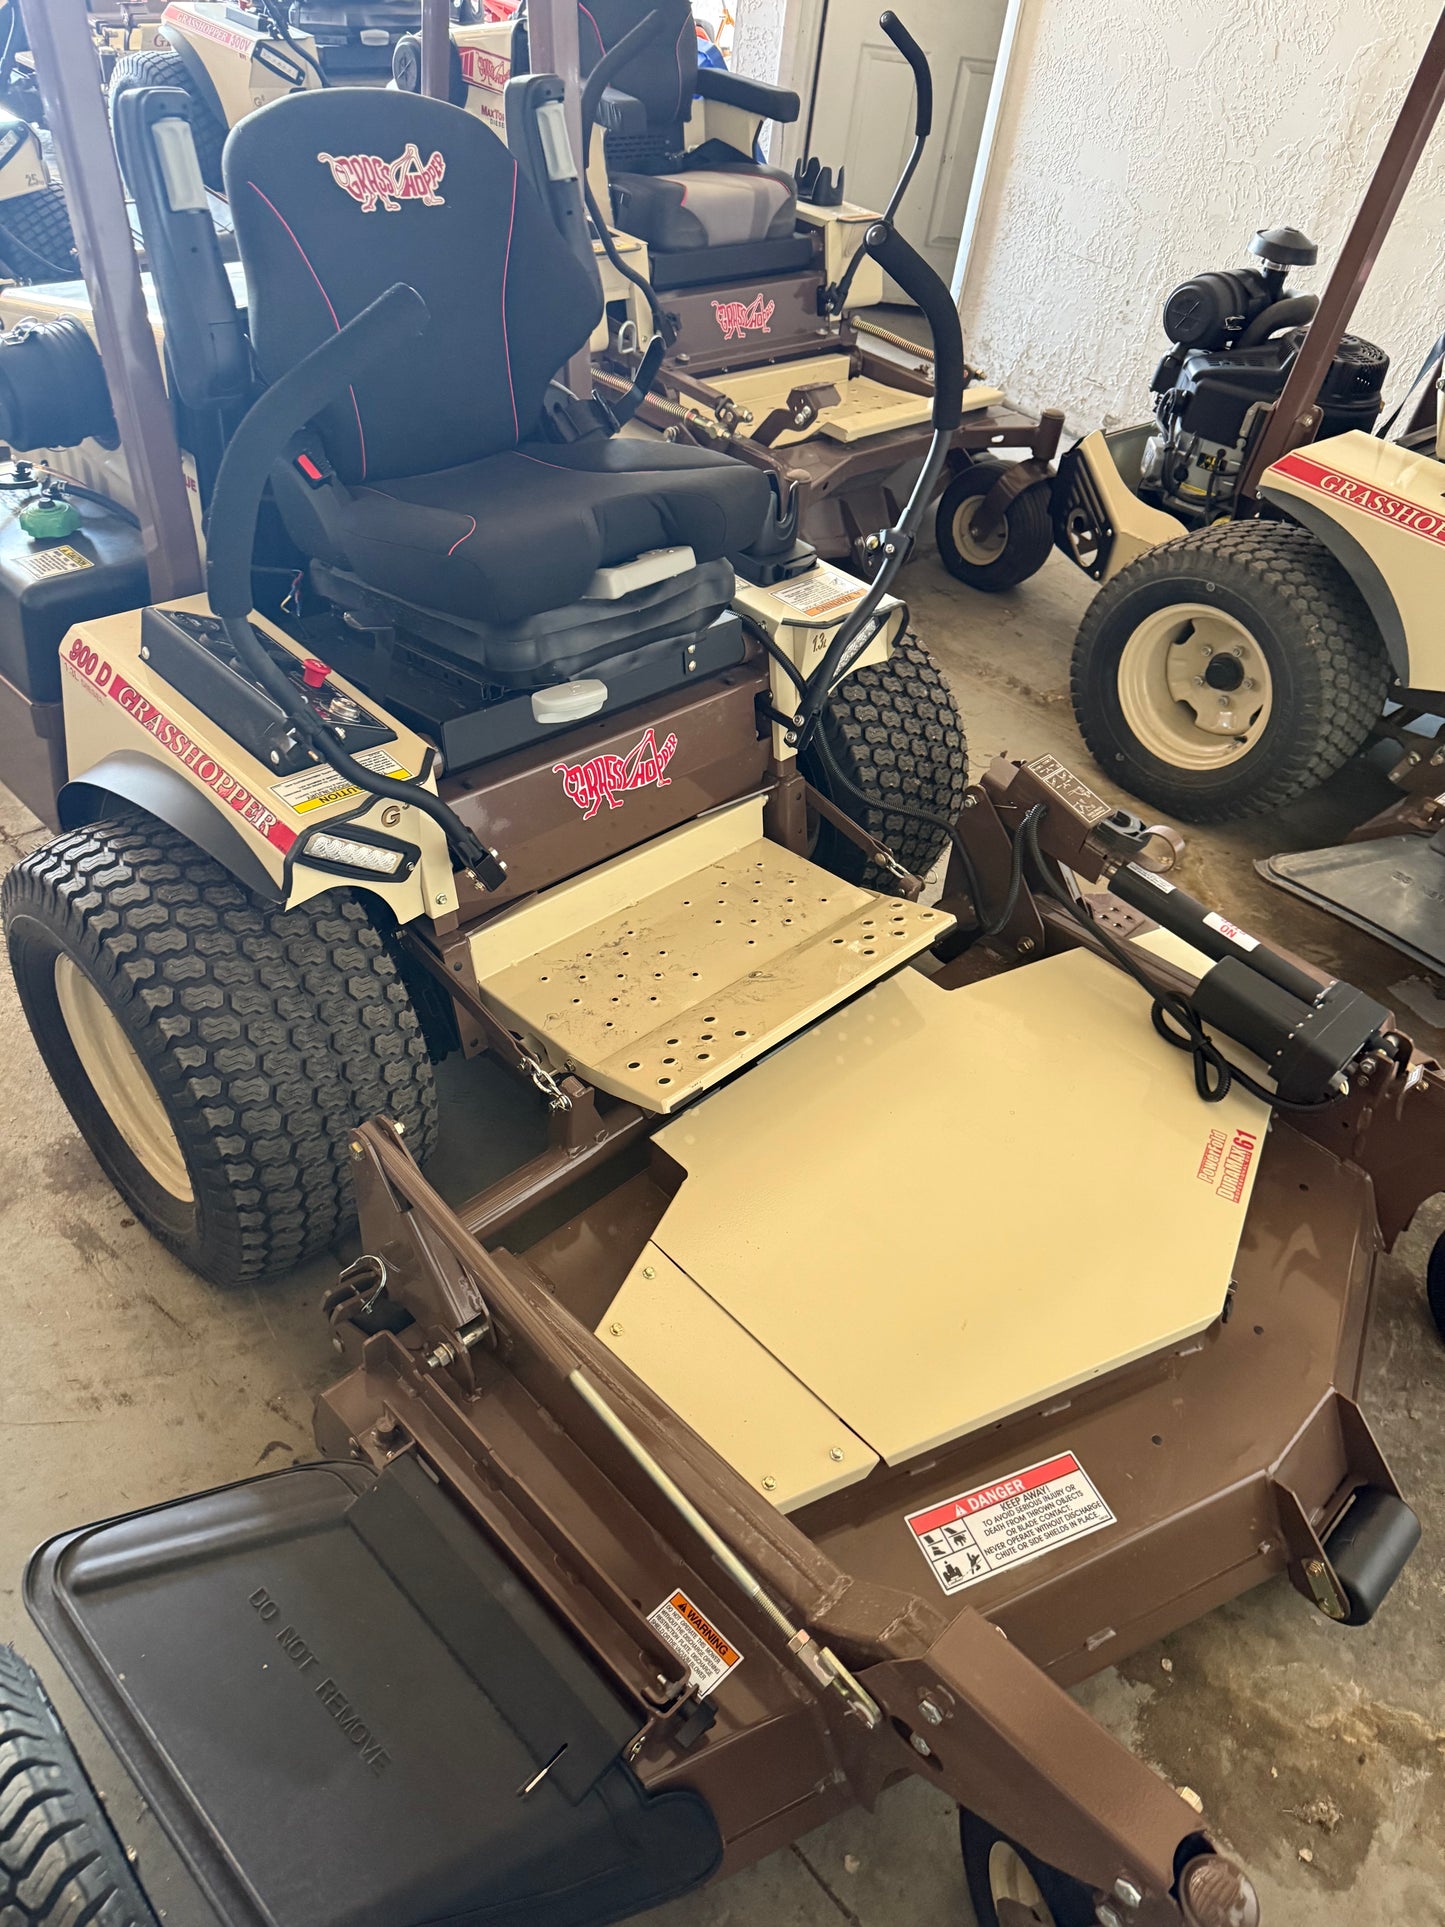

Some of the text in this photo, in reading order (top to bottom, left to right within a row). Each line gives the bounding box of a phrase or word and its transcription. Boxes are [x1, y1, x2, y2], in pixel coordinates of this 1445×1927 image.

[176, 13, 228, 42] GRASSHOPPER
[320, 144, 445, 210] GRASSHOPPER
[69, 638, 112, 687] 900 D
[118, 685, 277, 838] GRASSHOPPER
[552, 728, 678, 820] GRASSHOPPER
[1220, 924, 1236, 938] ON
[1233, 1129, 1257, 1150] 61
[967, 1479, 1025, 1512] DANGER
[982, 1484, 1076, 1527] TO AVOID SERIOUS INJURY OR
[984, 1490, 1084, 1537] DEATH FROM THROWN OBJECTS
[1000, 1485, 1050, 1511] KEEP AWAY!
[984, 1500, 1102, 1556] NEVER OPERATE WITHOUT DISCHARGE
[995, 1547, 1017, 1561] CHUTE
[1017, 1542, 1029, 1552] OR
[1029, 1534, 1044, 1547] SIDE
[1045, 1523, 1070, 1542] SHIELDS
[1070, 1521, 1078, 1529] IN
[1077, 1513, 1100, 1527] PLACE.
[1006, 1527, 1017, 1537] OR
[1017, 1518, 1039, 1533] BLADE
[650, 1618, 665, 1636] SHIELD
[689, 1661, 706, 1680] BLOWER
[655, 1614, 679, 1639] RESTRICTION
[691, 1651, 713, 1677] DISCHARGE
[660, 1609, 679, 1629] WITHOUT
[682, 1632, 705, 1659] DISCHARGE
[703, 1655, 720, 1674] OPENING
[666, 1604, 721, 1664] DO NOT OPERATE THIS MOWER
[687, 1610, 728, 1656] WARNING
[248, 1586, 391, 1777] DO NOT REMOVE
